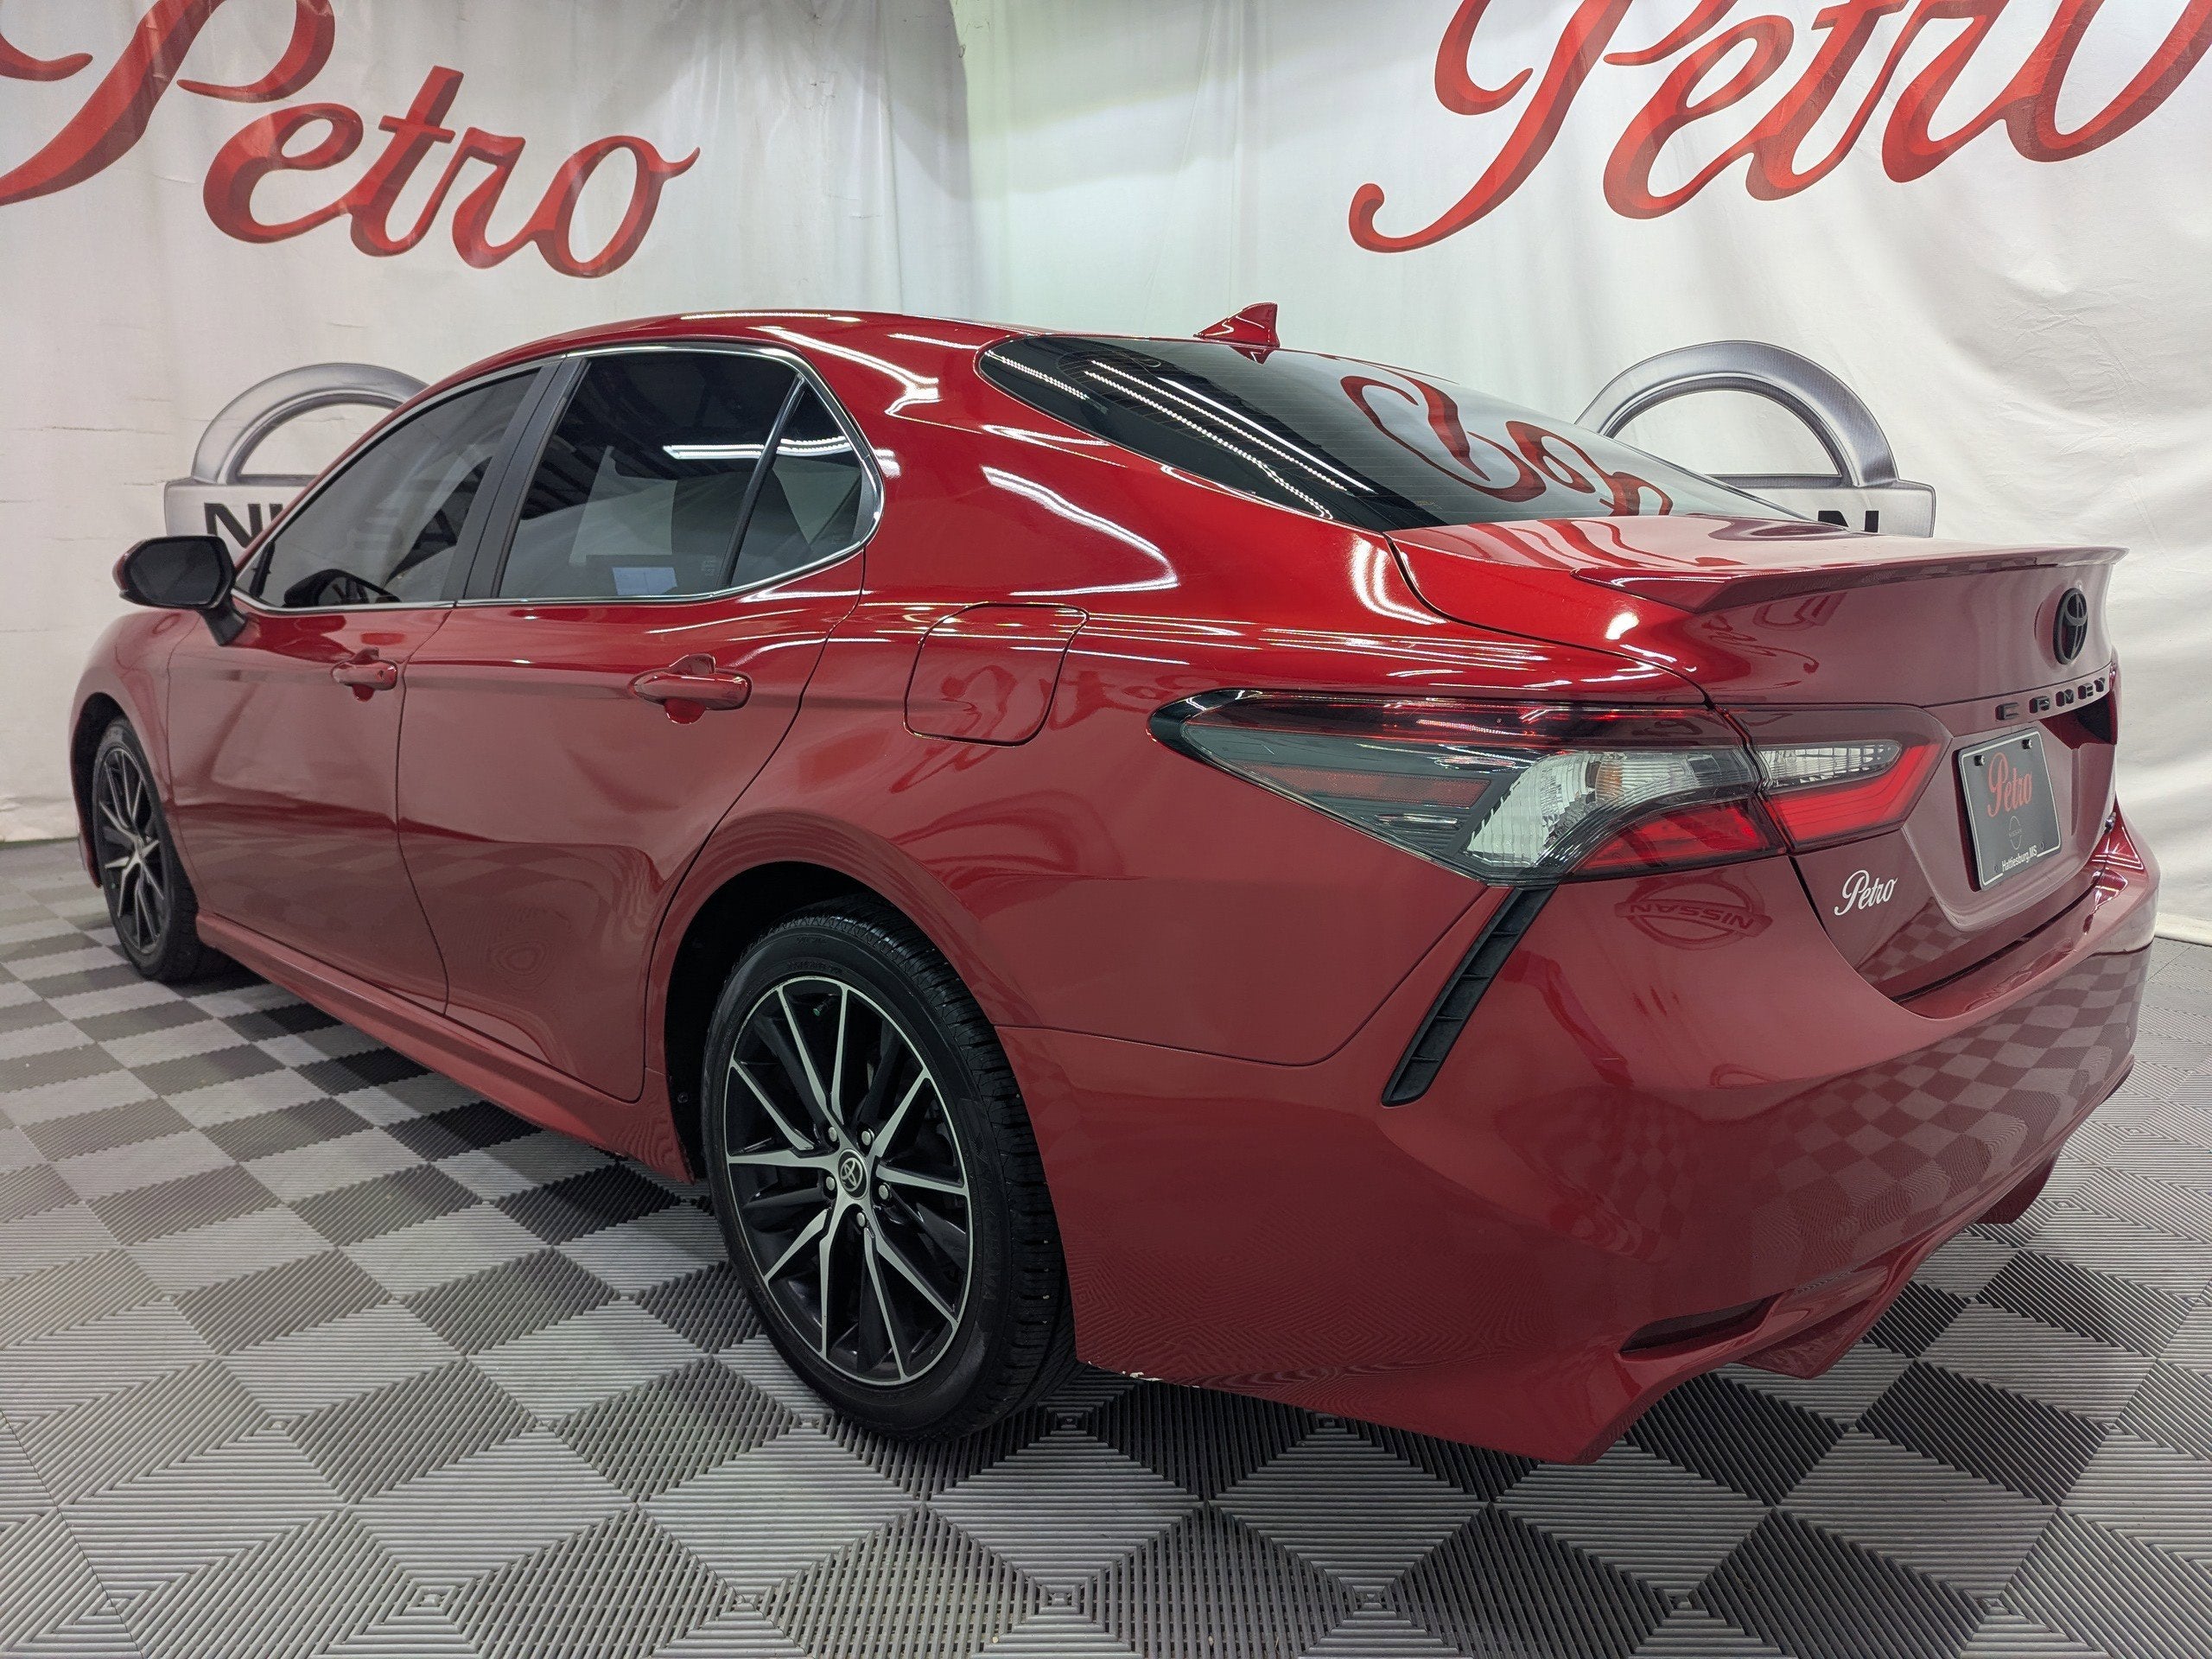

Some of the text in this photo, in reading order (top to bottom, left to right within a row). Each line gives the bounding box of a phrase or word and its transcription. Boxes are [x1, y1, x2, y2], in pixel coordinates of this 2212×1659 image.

[0, 0, 701, 278] Petro
[1348, 0, 2212, 253] Petro
[1995, 677, 2106, 721] CAMRY
[1987, 752, 2032, 817] Petro
[1834, 869, 1898, 916] Petro
